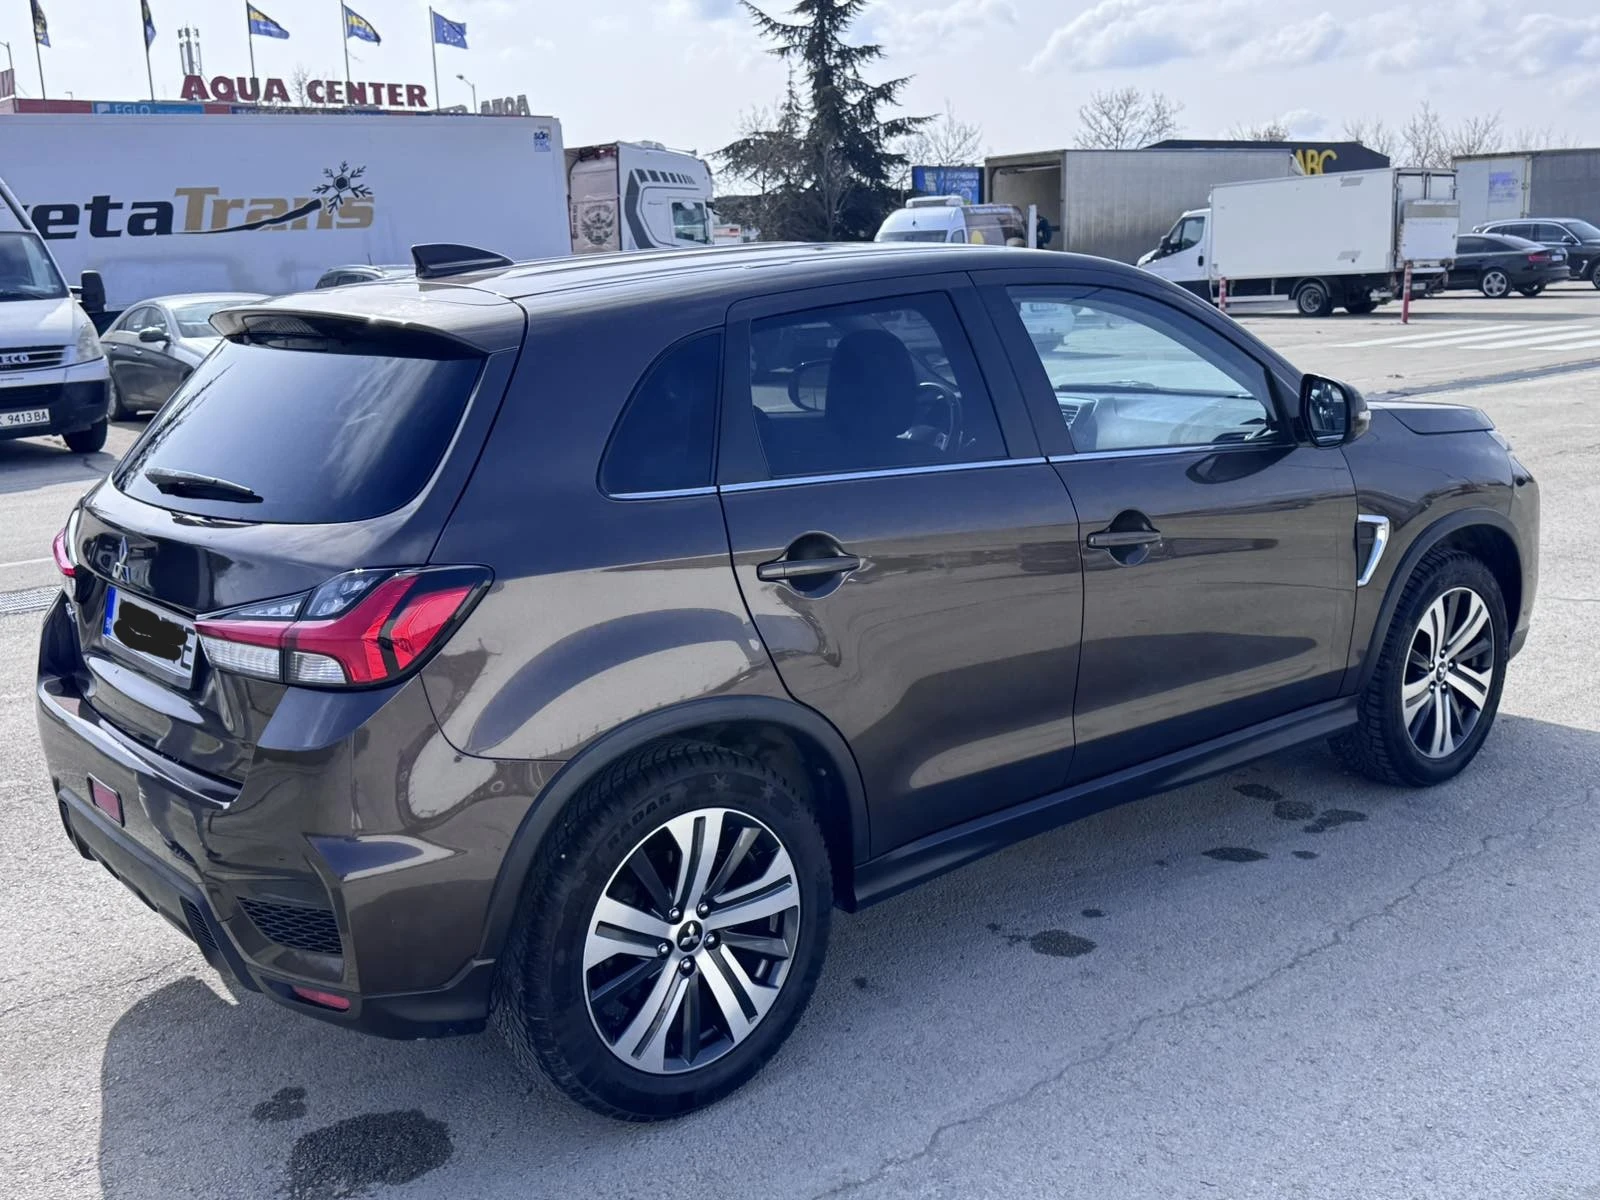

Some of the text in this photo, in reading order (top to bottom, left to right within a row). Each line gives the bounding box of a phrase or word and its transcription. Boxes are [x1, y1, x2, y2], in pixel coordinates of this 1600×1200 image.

[180, 74, 428, 107] AQUA CENTER
[22, 186, 375, 240] etaTrans
